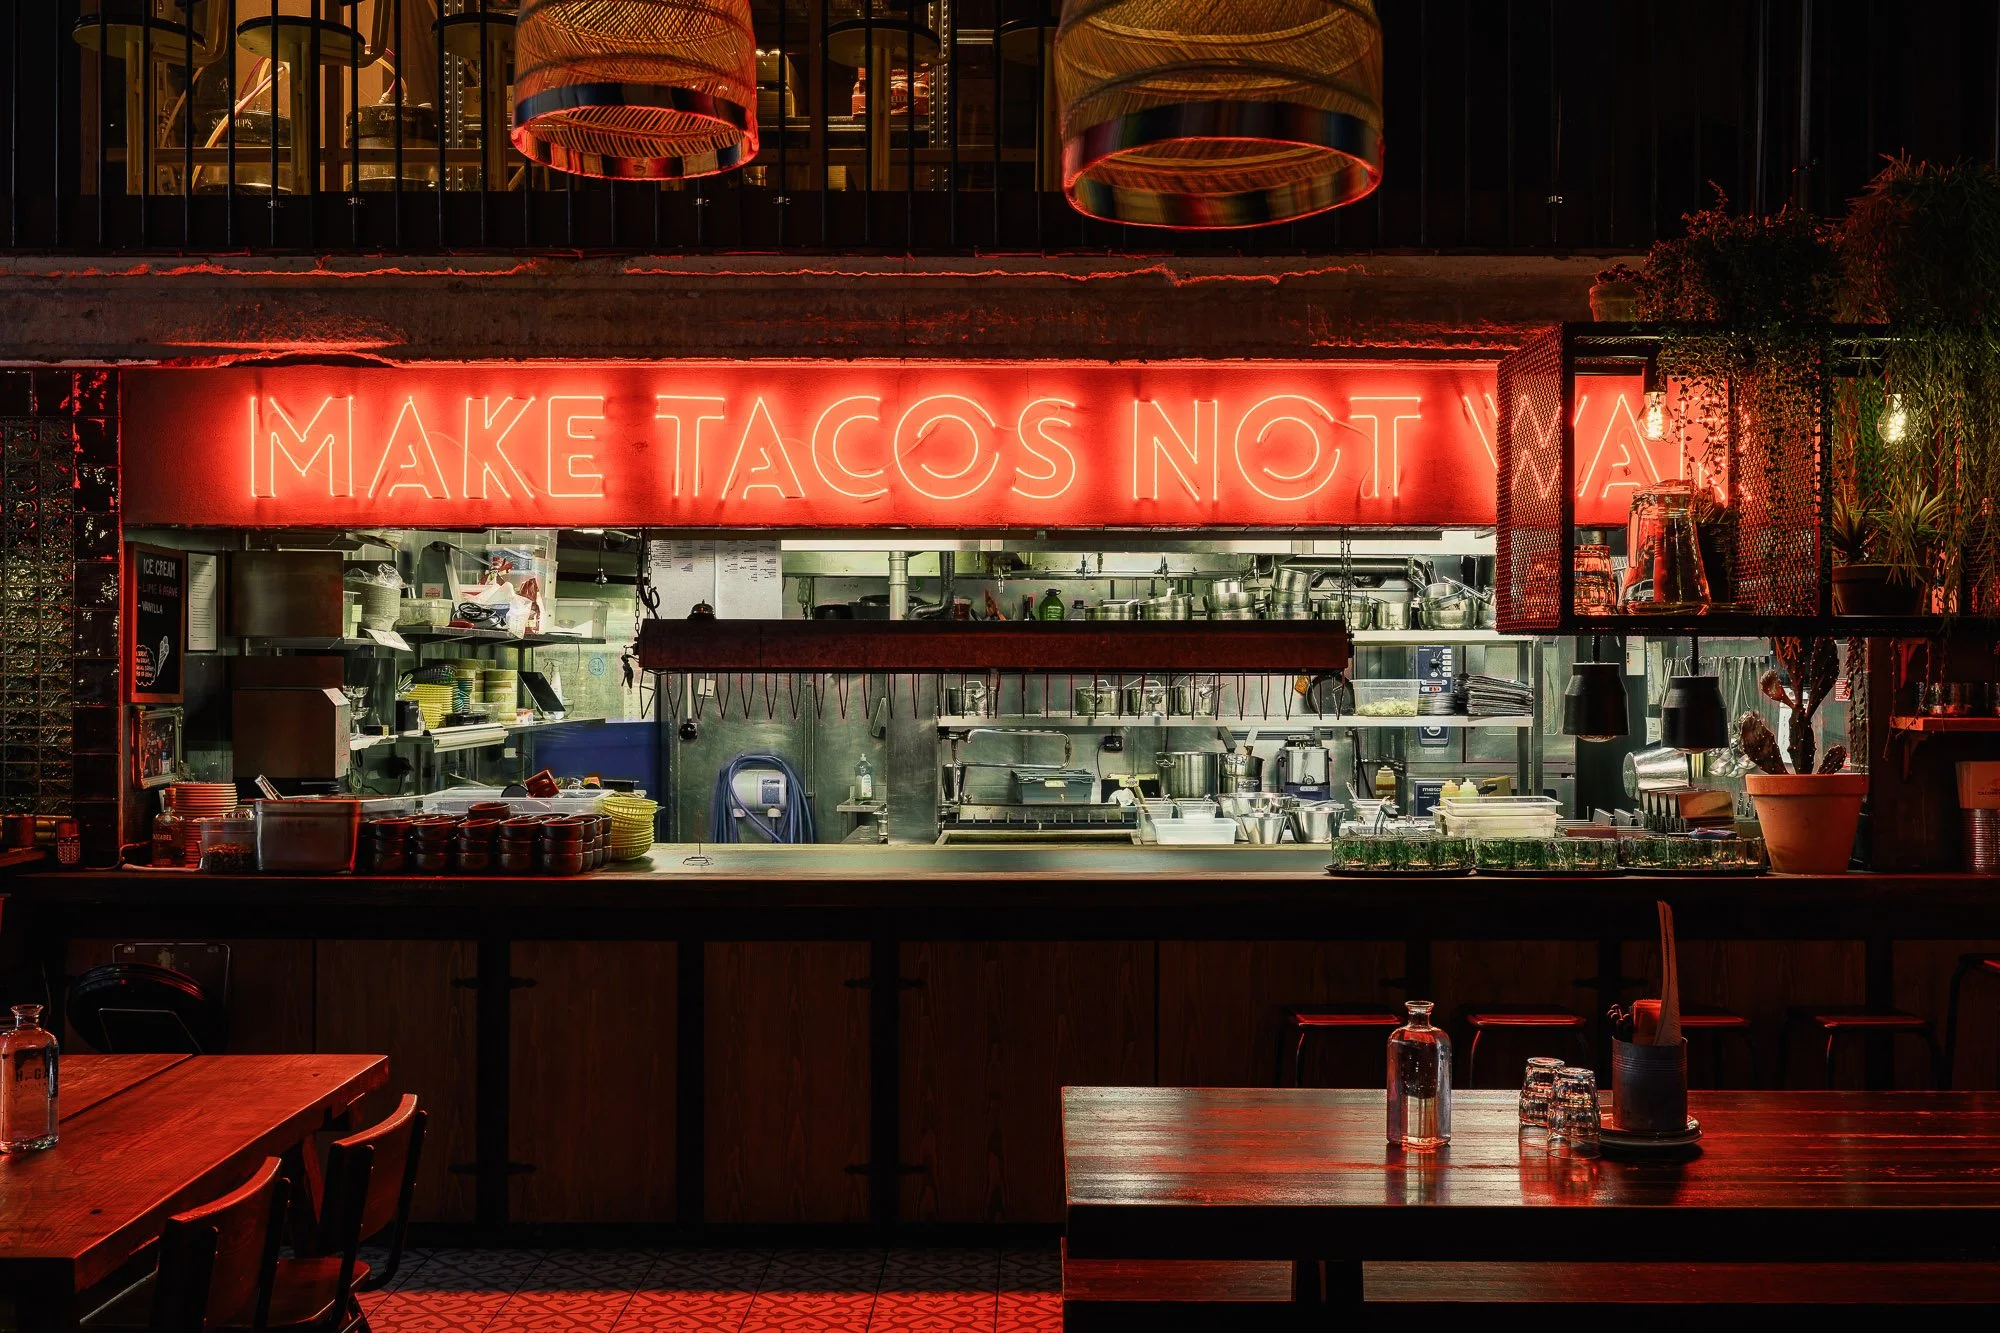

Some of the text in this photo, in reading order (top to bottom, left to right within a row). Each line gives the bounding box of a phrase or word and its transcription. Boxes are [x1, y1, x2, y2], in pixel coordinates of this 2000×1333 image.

[249, 394, 605, 499] MAKE
[655, 393, 1077, 500] TACOS
[1133, 394, 1423, 501] NOT
[143, 558, 176, 580] ICE CREAM
